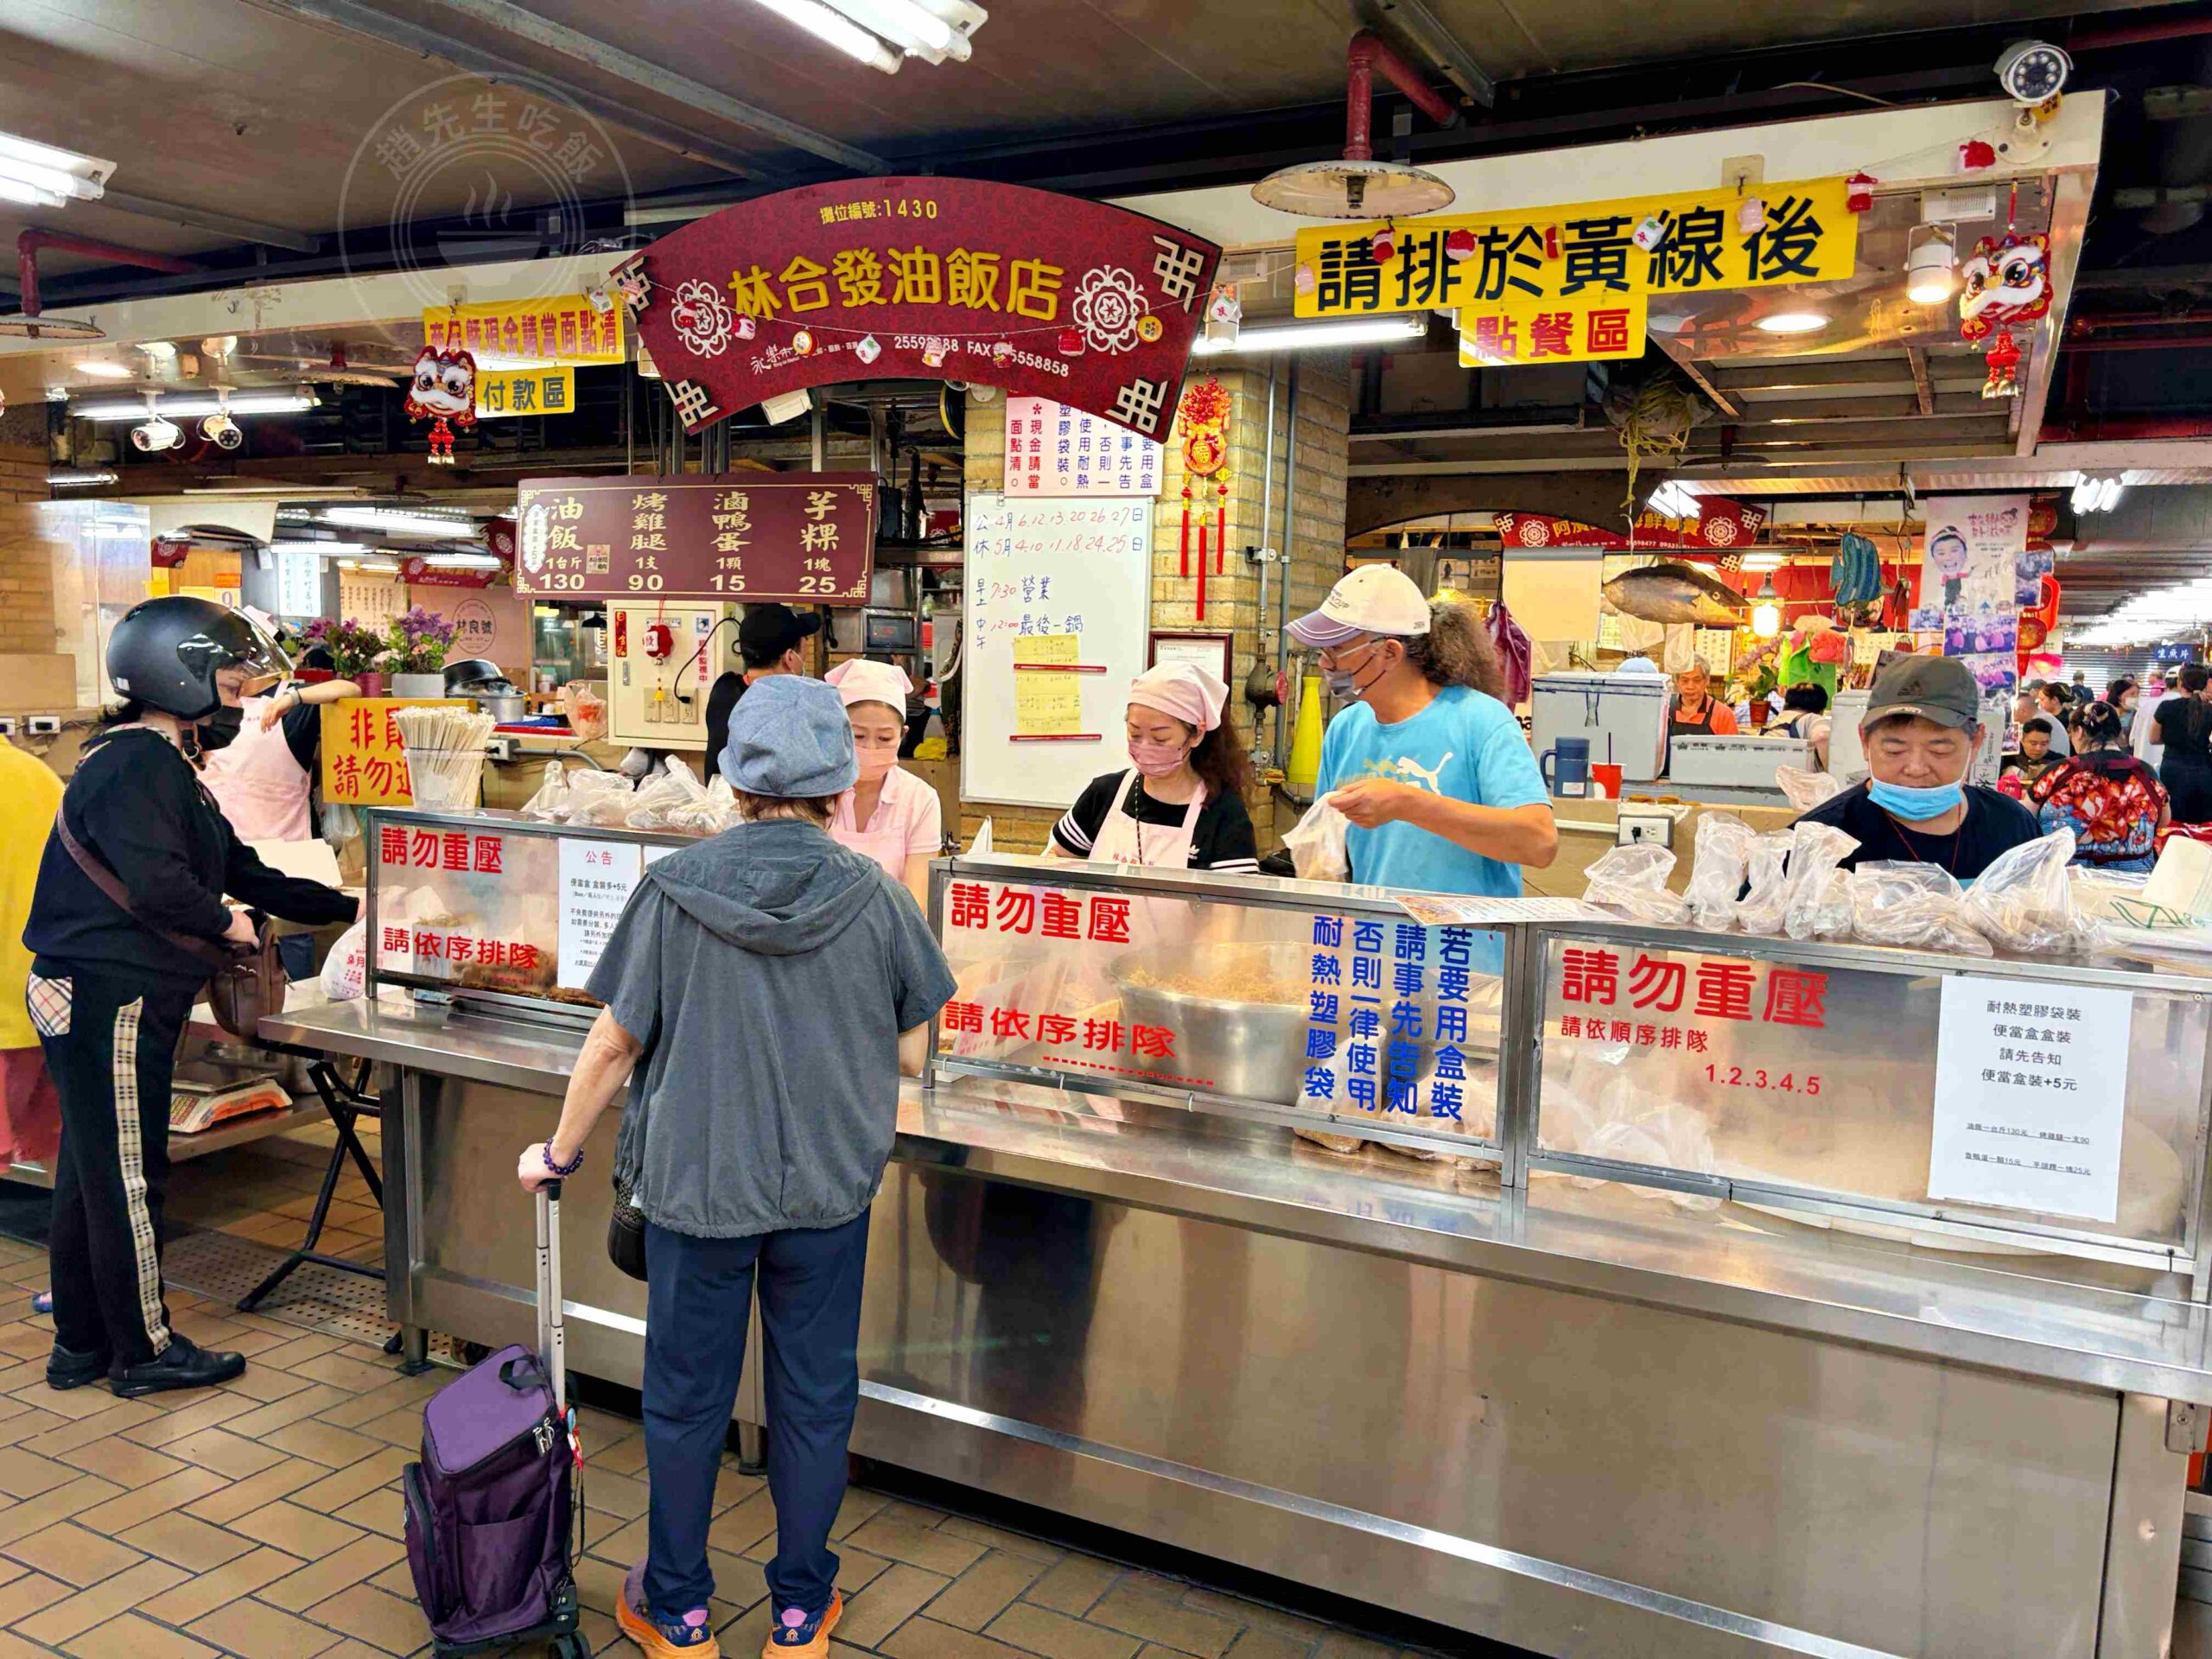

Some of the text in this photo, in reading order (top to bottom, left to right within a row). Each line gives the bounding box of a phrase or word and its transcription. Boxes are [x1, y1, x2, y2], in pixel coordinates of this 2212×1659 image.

[1318, 194, 1821, 311] 請排於黃線後
[728, 244, 1065, 321] 林合發油飯店
[894, 335, 959, 352] 255988
[1474, 308, 1630, 359] 點餐區
[750, 343, 799, 375] 永樂市
[967, 340, 1069, 378] FAX 5558858
[483, 376, 565, 412] 付款區
[1077, 411, 1092, 489] 使用耐熱
[548, 496, 584, 551] 油飯
[629, 493, 668, 551] 烤雞腿
[710, 493, 752, 553] 滷鴨蛋
[799, 491, 841, 553] 芋粿
[545, 556, 582, 570] 1台斤
[635, 557, 658, 571] 1支
[715, 557, 741, 571] 1顆
[803, 557, 832, 572] 1塊
[538, 574, 586, 590] 130
[628, 575, 664, 591] 90
[710, 575, 746, 591] 15
[799, 575, 836, 593] 25
[1021, 575, 1052, 603] 營業
[1019, 613, 1084, 636] 最後一鍋
[380, 827, 503, 874] 請勿重壓
[585, 850, 613, 866] 公告
[950, 883, 1131, 944] 請勿重壓
[384, 926, 540, 969] 請依序排隊
[1561, 949, 1830, 1029] 請勿重壓
[1305, 915, 1344, 1100] 耐熱塑膠袋
[1346, 920, 1384, 1112] 否則一律使用
[1387, 924, 1427, 1115] 請事先告知
[1431, 926, 1472, 1122] 若要用盒裝
[1986, 1000, 2082, 1021] 耐熱塑膠袋裝
[944, 1000, 1177, 1059] 請依序排隊
[1561, 1016, 1708, 1053] 請依順序排隊
[1993, 1023, 2072, 1044] 便當盒盒裝
[1999, 1047, 2062, 1065] 請先告知
[1704, 1064, 1821, 1096] 1.2.3.4.5
[1981, 1068, 2078, 1090] 便當盒裝+5元
